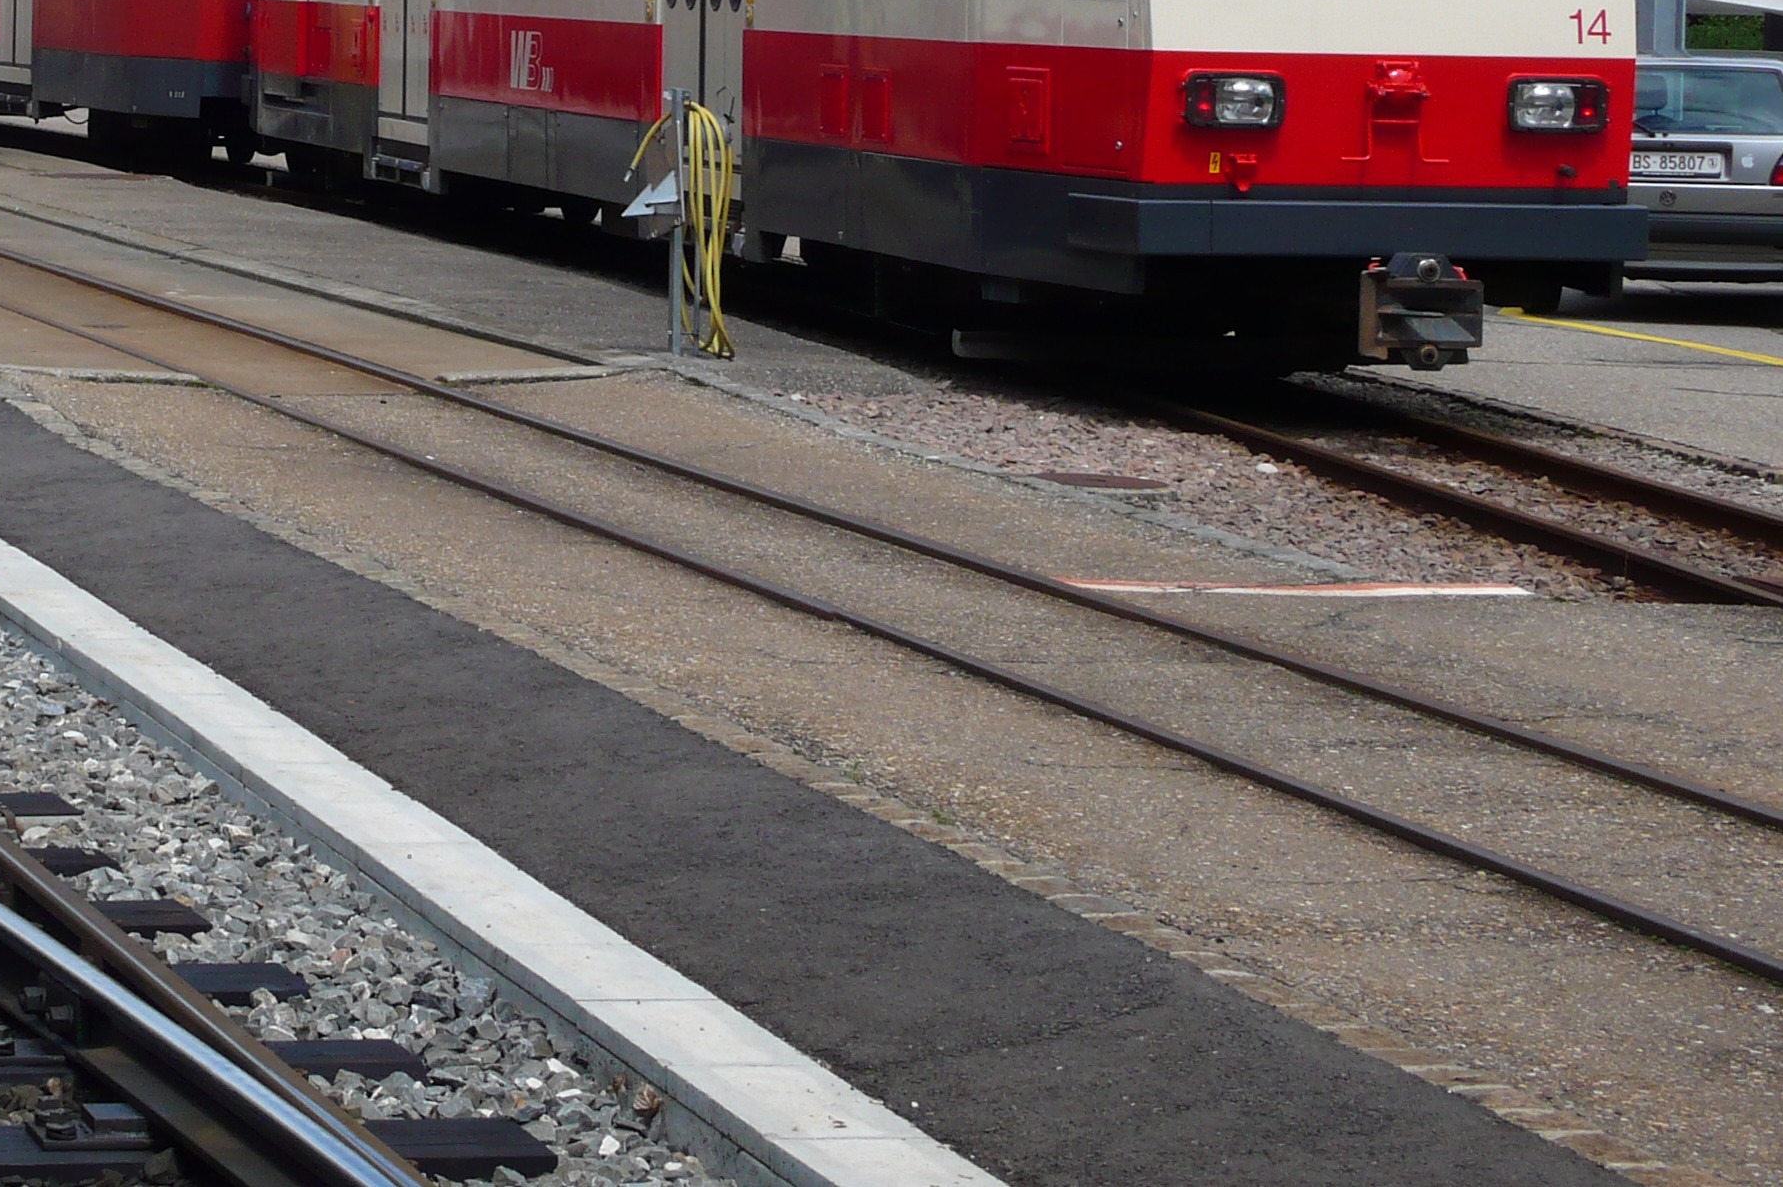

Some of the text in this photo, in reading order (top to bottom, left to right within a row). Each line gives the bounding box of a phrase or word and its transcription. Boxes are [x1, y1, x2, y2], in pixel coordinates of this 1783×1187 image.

[1569, 8, 1612, 45] 14
[1632, 154, 1706, 170] BS 85807
